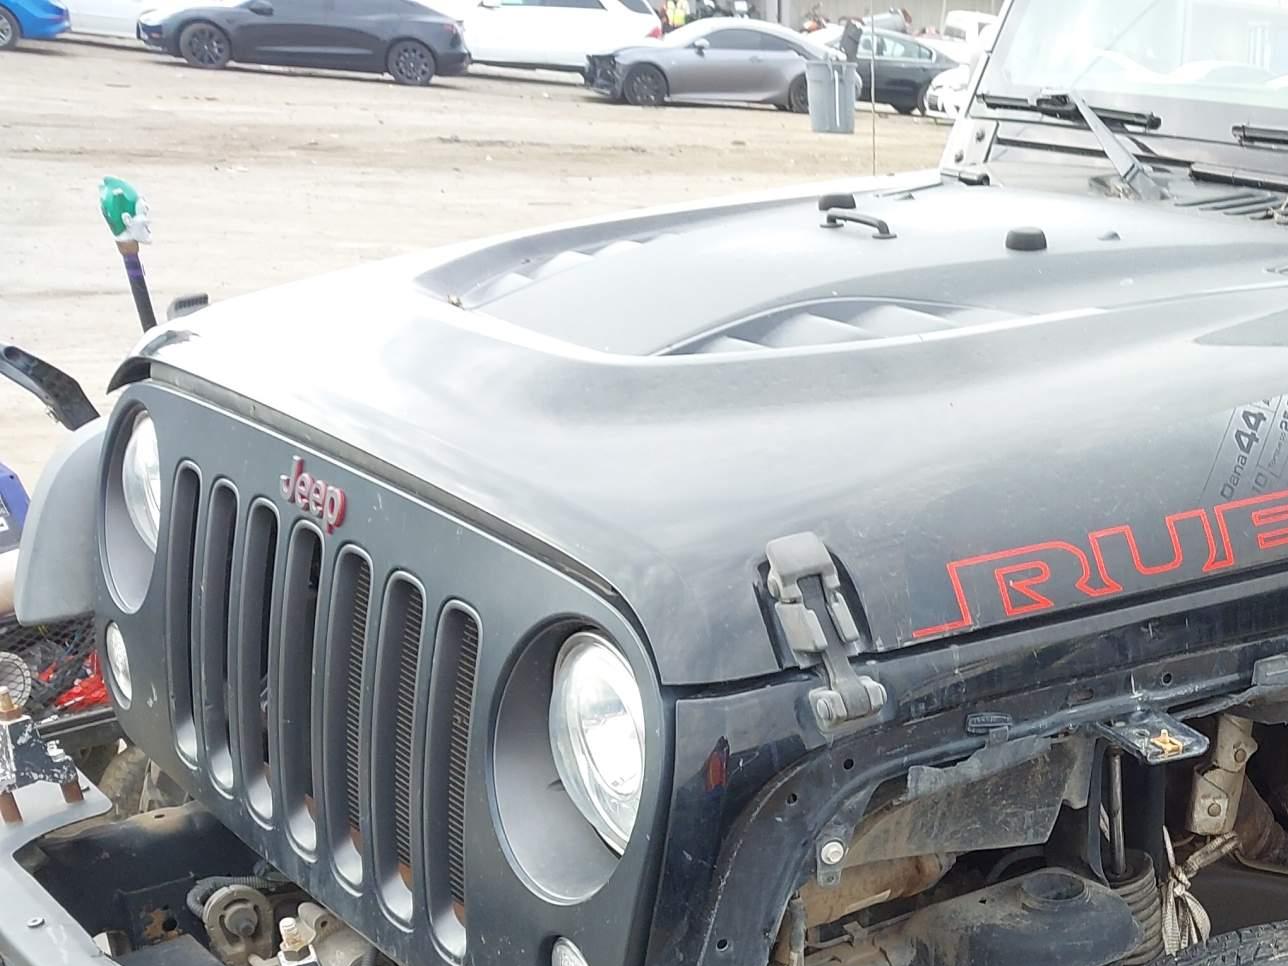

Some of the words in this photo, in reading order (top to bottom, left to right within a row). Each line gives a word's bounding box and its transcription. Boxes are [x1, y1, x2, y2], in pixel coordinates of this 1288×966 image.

[280, 455, 347, 535] Jeep
[1220, 454, 1248, 500] Dana
[1234, 409, 1267, 455] 44
